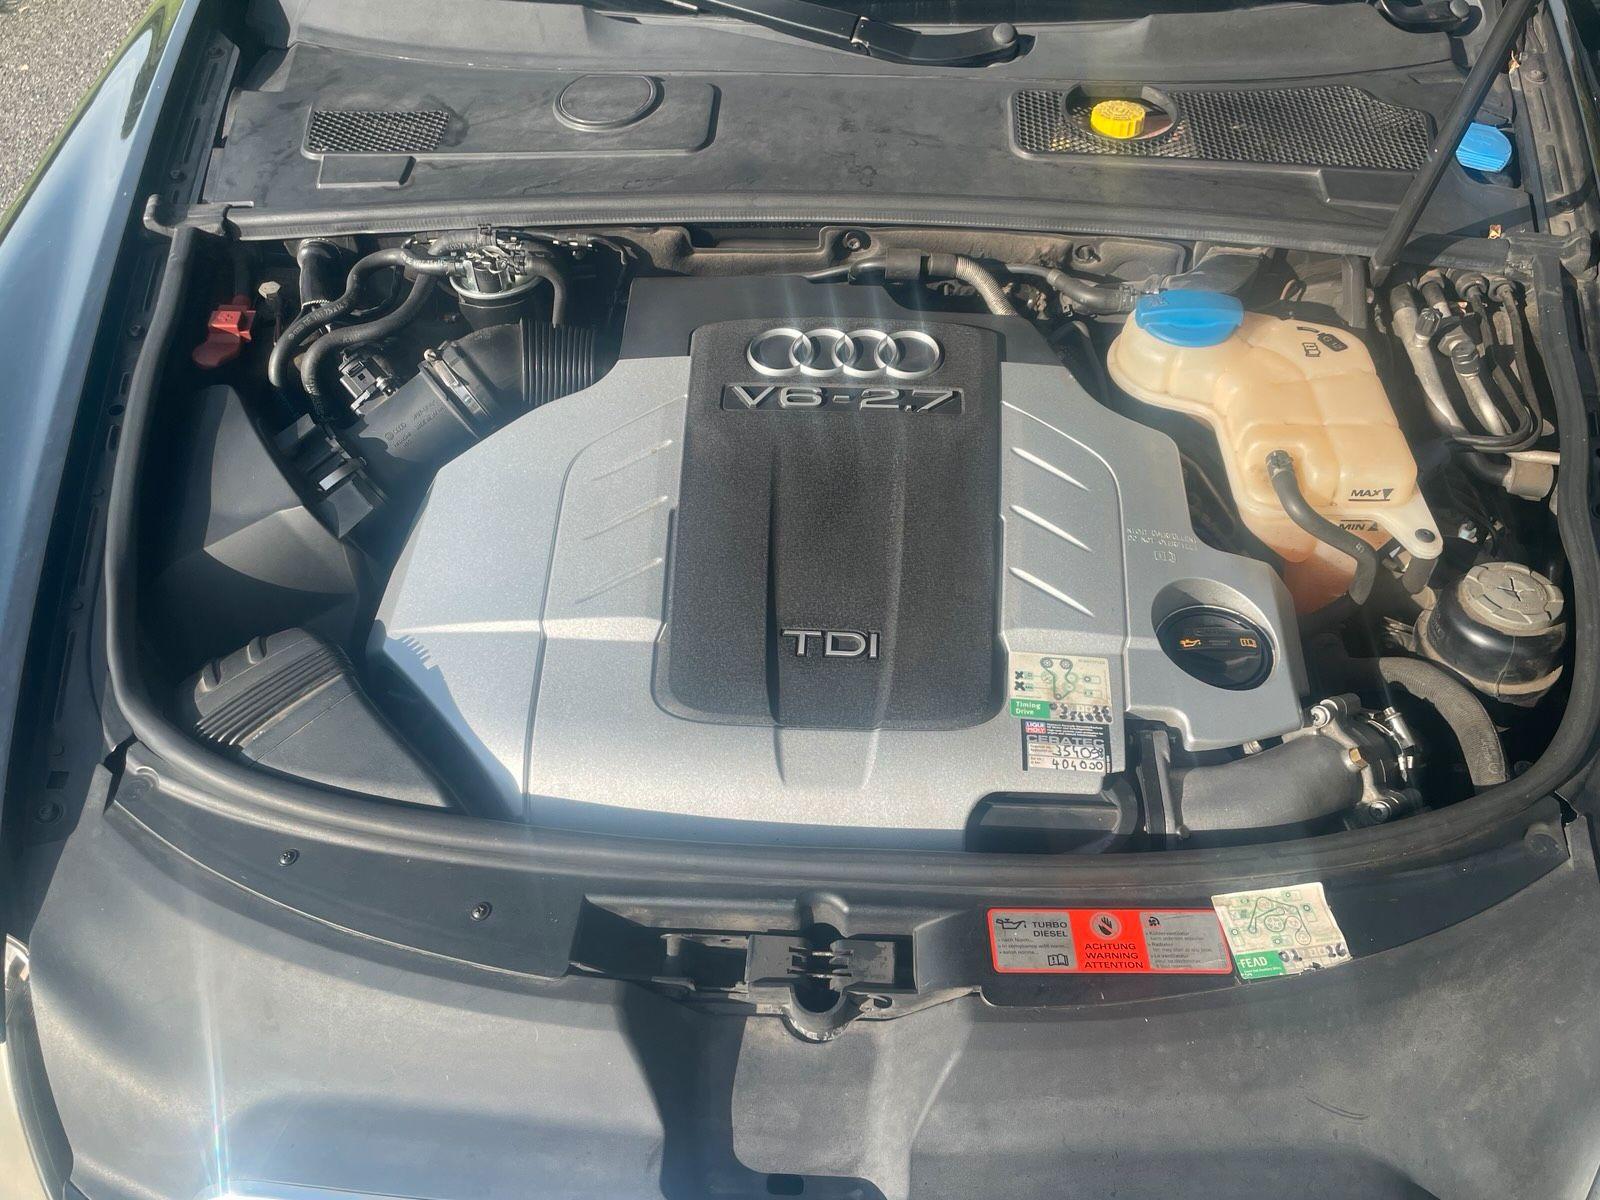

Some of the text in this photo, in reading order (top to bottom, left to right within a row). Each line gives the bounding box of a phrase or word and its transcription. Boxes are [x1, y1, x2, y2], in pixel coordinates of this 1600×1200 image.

[731, 384, 954, 413] V6-2.7
[1351, 489, 1381, 497] MAX
[1340, 523, 1365, 531] MIN
[781, 629, 880, 659] TDI
[1015, 701, 1041, 710] Timing
[1240, 956, 1268, 969] FEAD
